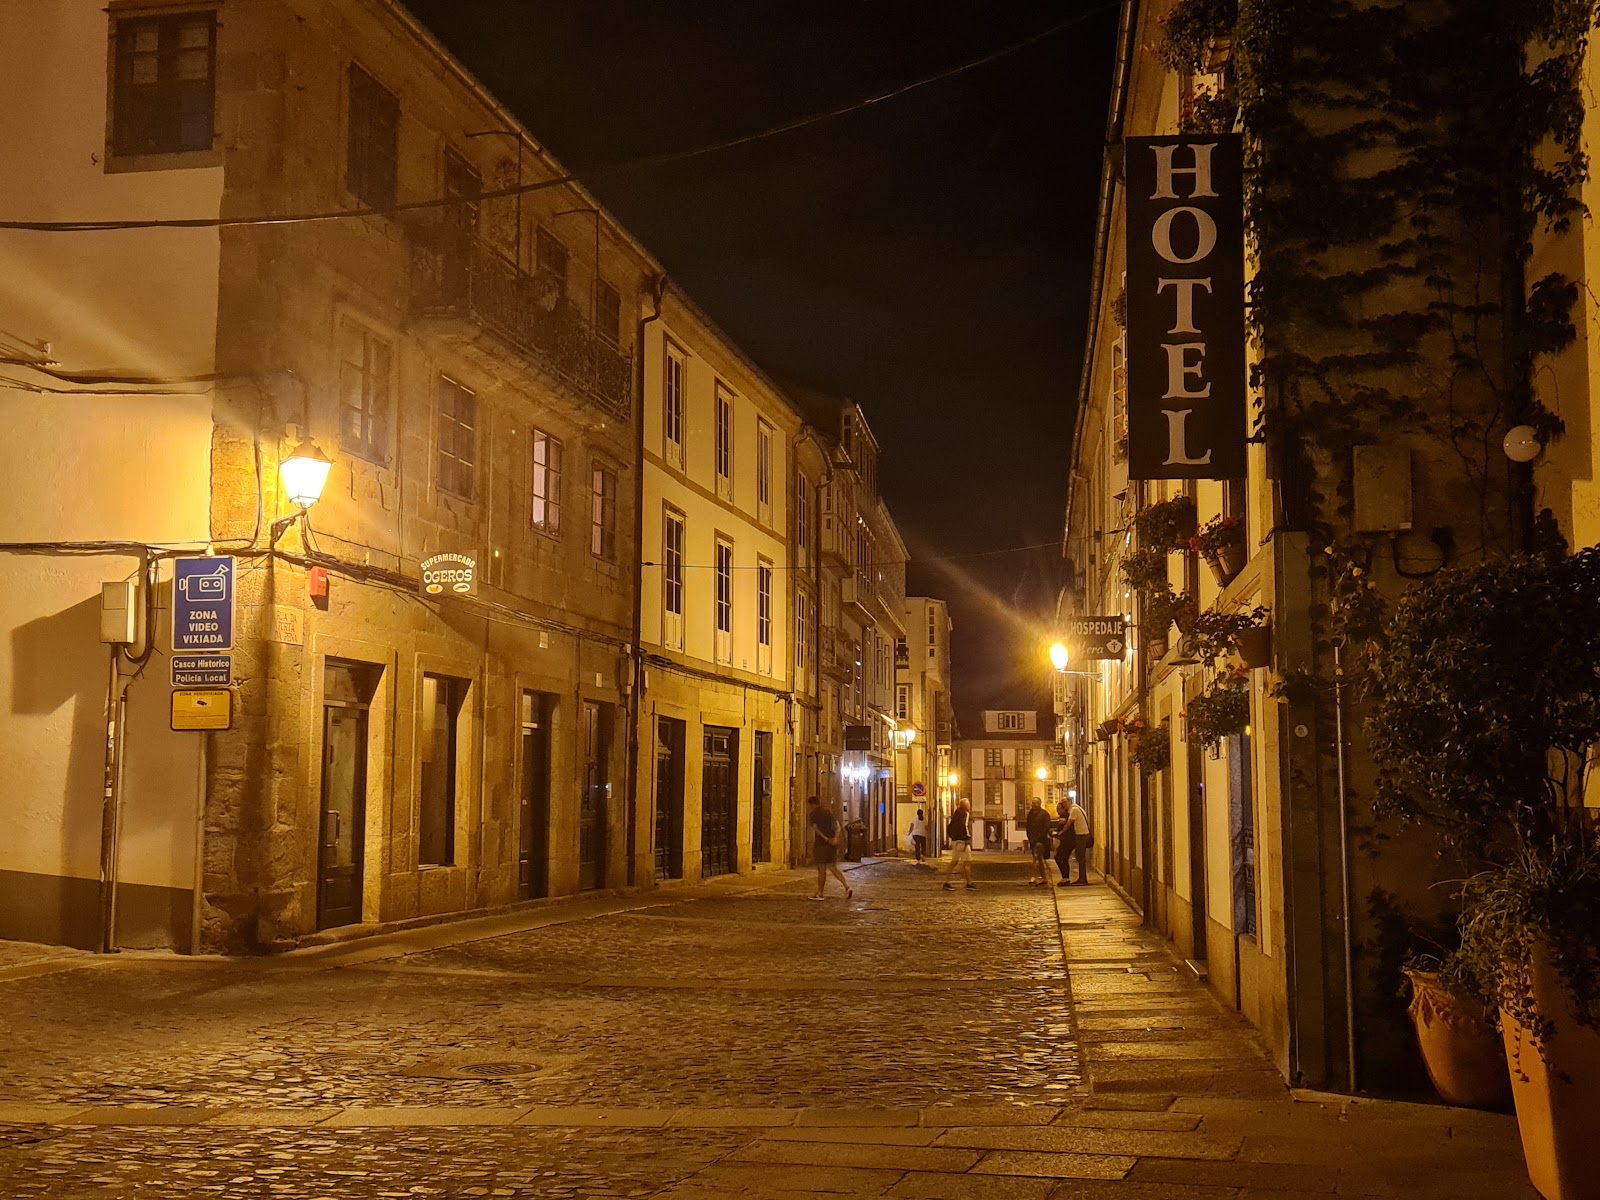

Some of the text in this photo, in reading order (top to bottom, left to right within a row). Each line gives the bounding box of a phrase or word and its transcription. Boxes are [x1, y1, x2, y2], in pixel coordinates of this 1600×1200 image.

[1149, 142, 1219, 466] HOTEL
[420, 553, 476, 571] SUPERMERCADO
[423, 569, 473, 584] OGEROS
[189, 610, 218, 620] ZONA
[189, 622, 219, 632] VIDEO
[1070, 621, 1123, 635] HOSPEDAJE
[183, 634, 223, 644] VIXIADA
[173, 660, 196, 668] Casco
[204, 673, 227, 682] Local
